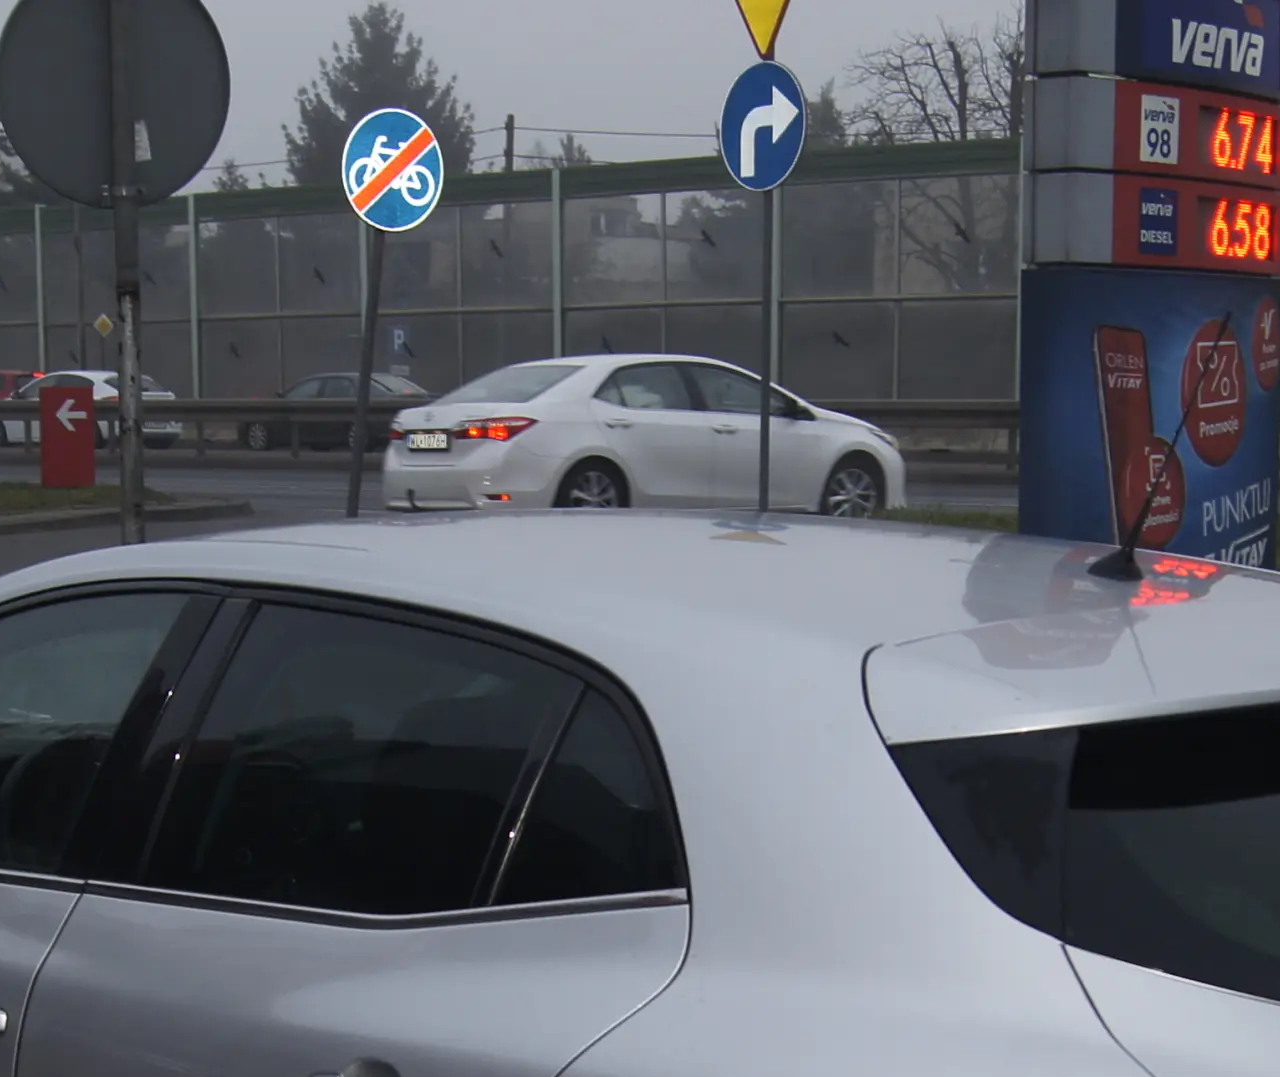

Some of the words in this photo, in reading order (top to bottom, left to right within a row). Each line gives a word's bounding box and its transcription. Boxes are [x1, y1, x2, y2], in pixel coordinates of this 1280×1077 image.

[1171, 18, 1265, 77] verva
[1144, 107, 1175, 124] verva
[1146, 128, 1171, 159] 98
[1213, 107, 1273, 175] 6.74
[1141, 201, 1173, 217] verva
[1140, 229, 1173, 245] DIESEL
[1211, 198, 1272, 260] 6.58
[394, 329, 405, 351] P
[1105, 352, 1144, 370] ORLEN
[1107, 373, 1143, 389] VITAY
[1199, 415, 1240, 438] Promocje
[1202, 478, 1271, 537] PUNKTUJ
